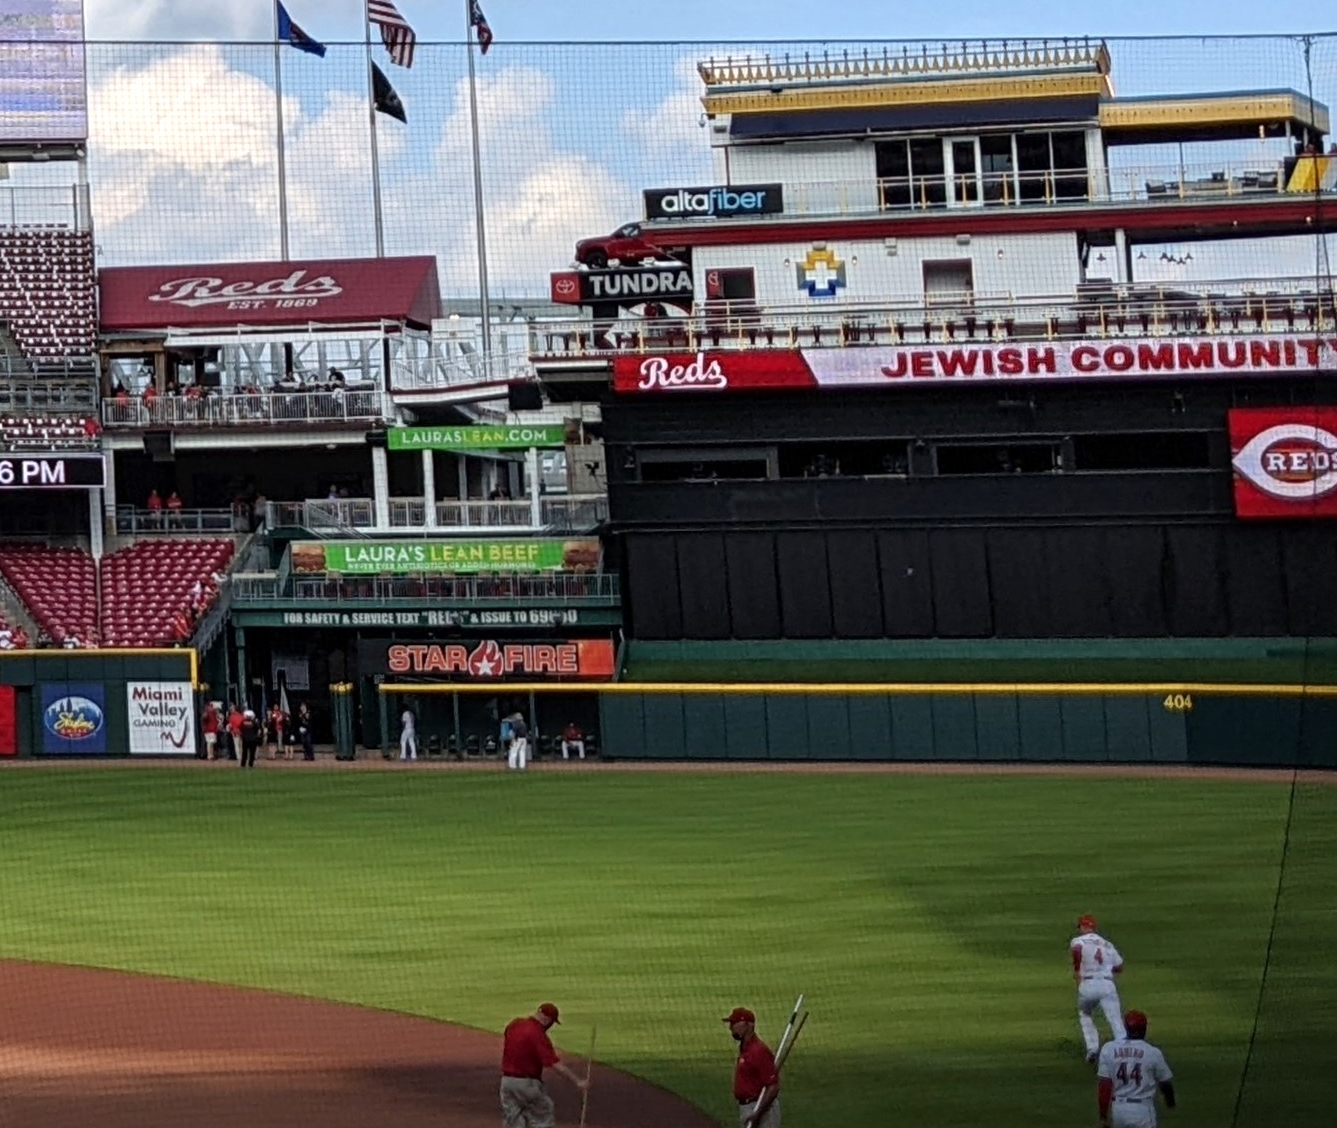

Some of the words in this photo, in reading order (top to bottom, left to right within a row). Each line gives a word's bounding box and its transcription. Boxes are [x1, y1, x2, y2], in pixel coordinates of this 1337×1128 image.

[660, 187, 767, 215] altafiber
[148, 269, 343, 307] Reds
[588, 271, 694, 296] TUNDRA
[638, 352, 728, 390] Reds
[881, 347, 1057, 378] JEWISH
[401, 428, 548, 445] LAURASLEAN.COM
[21, 460, 66, 484] PM
[1265, 451, 1337, 471] RED
[344, 545, 425, 562] LAURA'S
[430, 544, 484, 562] LEAN
[488, 543, 539, 561] BEEF
[284, 613, 304, 625] FOR
[304, 613, 340, 624] SAFETY
[352, 612, 394, 624] SERVICE
[396, 612, 420, 624] TEXT
[481, 611, 512, 623] ISSUE
[513, 611, 527, 623] TO
[387, 644, 468, 671] STAR
[503, 644, 578, 671] FIRE
[132, 686, 183, 701] Miami
[1163, 693, 1193, 709] 404
[138, 702, 188, 720] Valley
[133, 719, 176, 728] GAMING
[1116, 1062, 1144, 1087] 44
